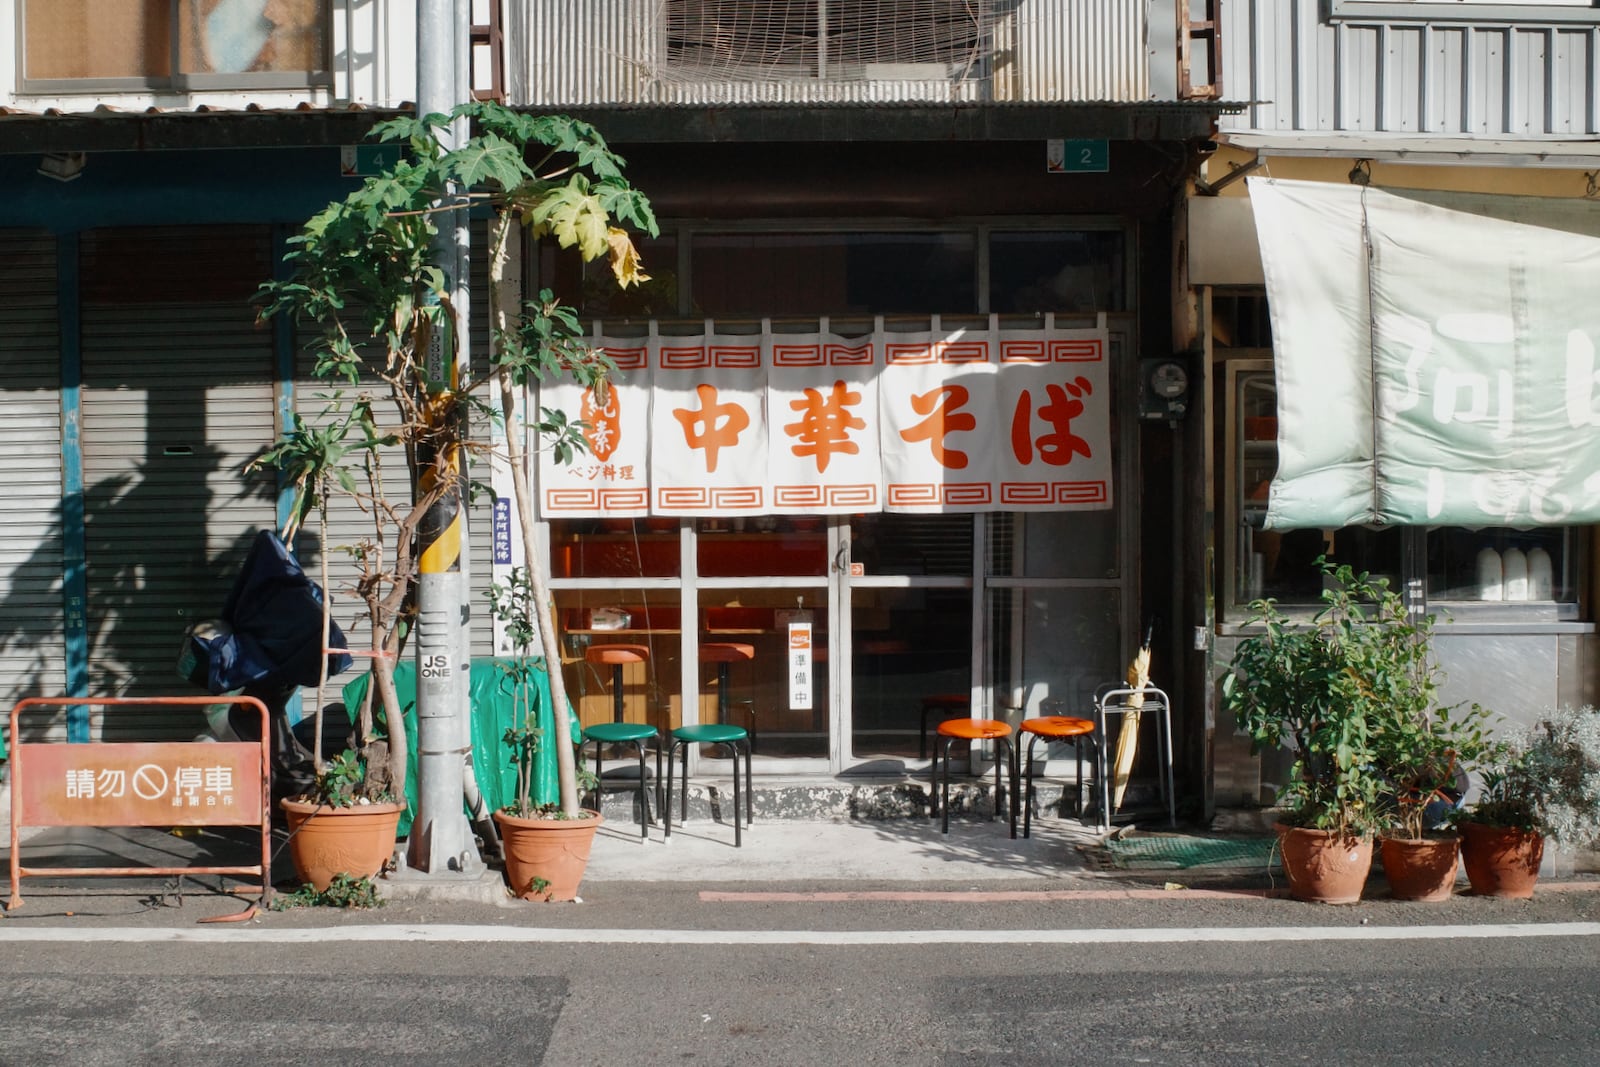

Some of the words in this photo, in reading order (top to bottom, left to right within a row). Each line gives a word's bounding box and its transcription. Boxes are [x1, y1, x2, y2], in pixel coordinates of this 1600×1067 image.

[373, 152, 384, 168] 4
[1080, 148, 1092, 164] 2
[1374, 313, 1600, 440] 阿
[672, 376, 1092, 474] 中華そば
[568, 464, 635, 481] ベジ料理
[424, 655, 447, 668] JS
[421, 668, 451, 678] ONE
[795, 654, 807, 704] 準備中
[65, 769, 126, 799] 請勿
[173, 765, 234, 796] 停車
[172, 796, 233, 807] 謝謝合作
